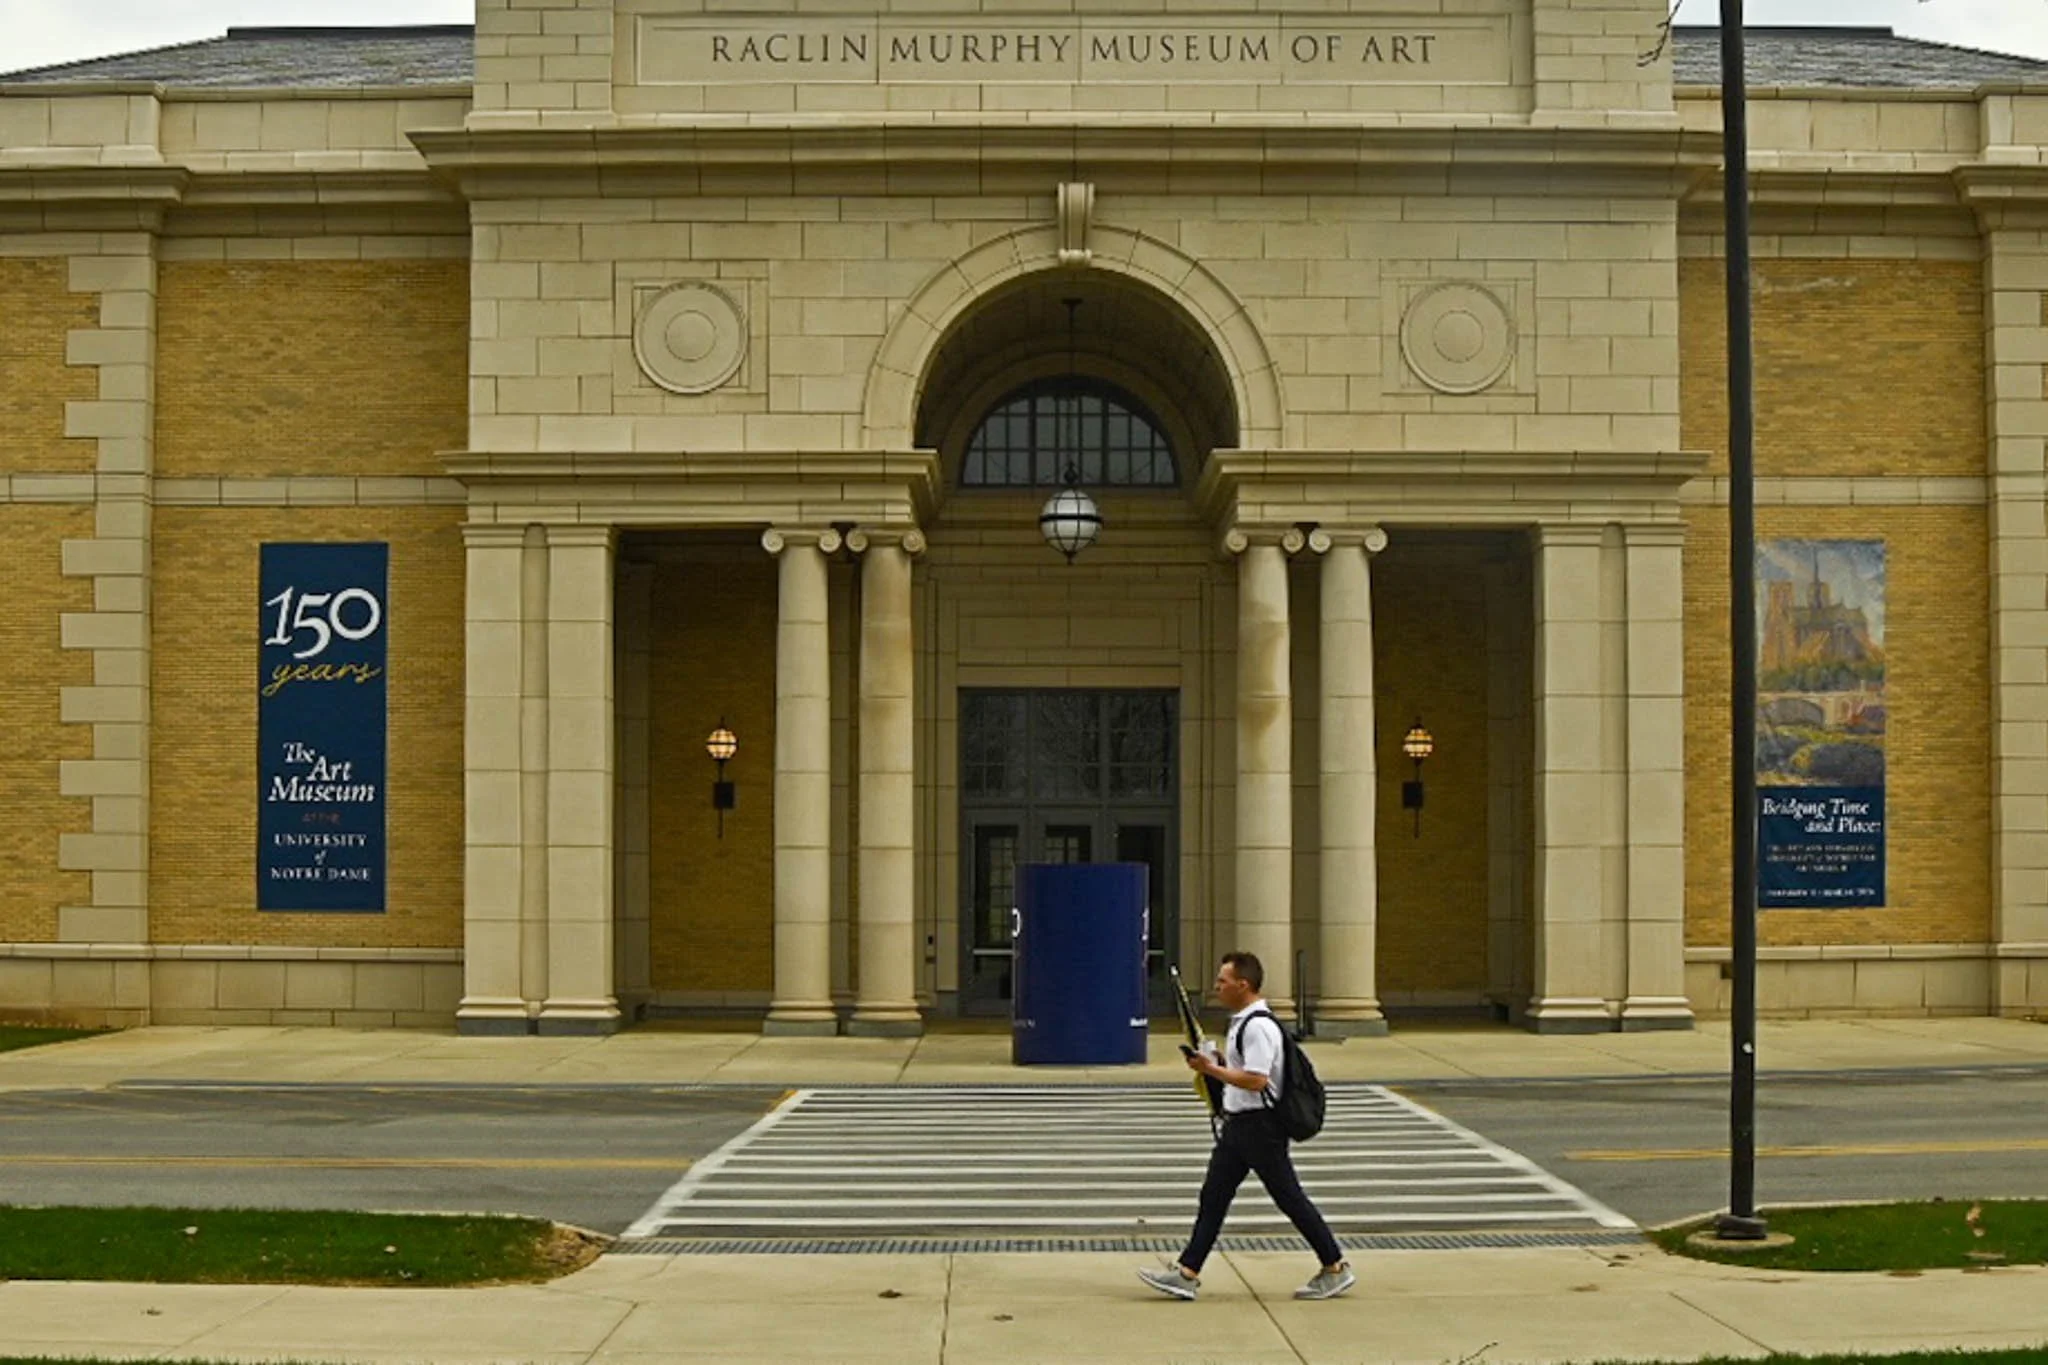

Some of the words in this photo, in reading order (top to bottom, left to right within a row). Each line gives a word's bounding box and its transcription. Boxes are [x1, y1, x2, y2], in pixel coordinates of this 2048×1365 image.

[712, 33, 868, 63] RACLIN
[889, 34, 1072, 63] MURPHY
[1092, 34, 1270, 63] MUSEUM
[1292, 34, 1344, 63] OF
[1361, 34, 1436, 63] ART
[264, 586, 381, 659] 150
[261, 661, 382, 697] years
[283, 742, 316, 763] The
[306, 756, 352, 782] Art
[268, 776, 375, 802] Museum
[1762, 797, 1826, 820] Bridging
[1829, 798, 1869, 815] Time
[1804, 817, 1834, 833] and
[274, 833, 367, 847] UNIVERSITY
[313, 849, 327, 866] of
[271, 867, 323, 881] NOTRE
[328, 867, 371, 881] DAME
